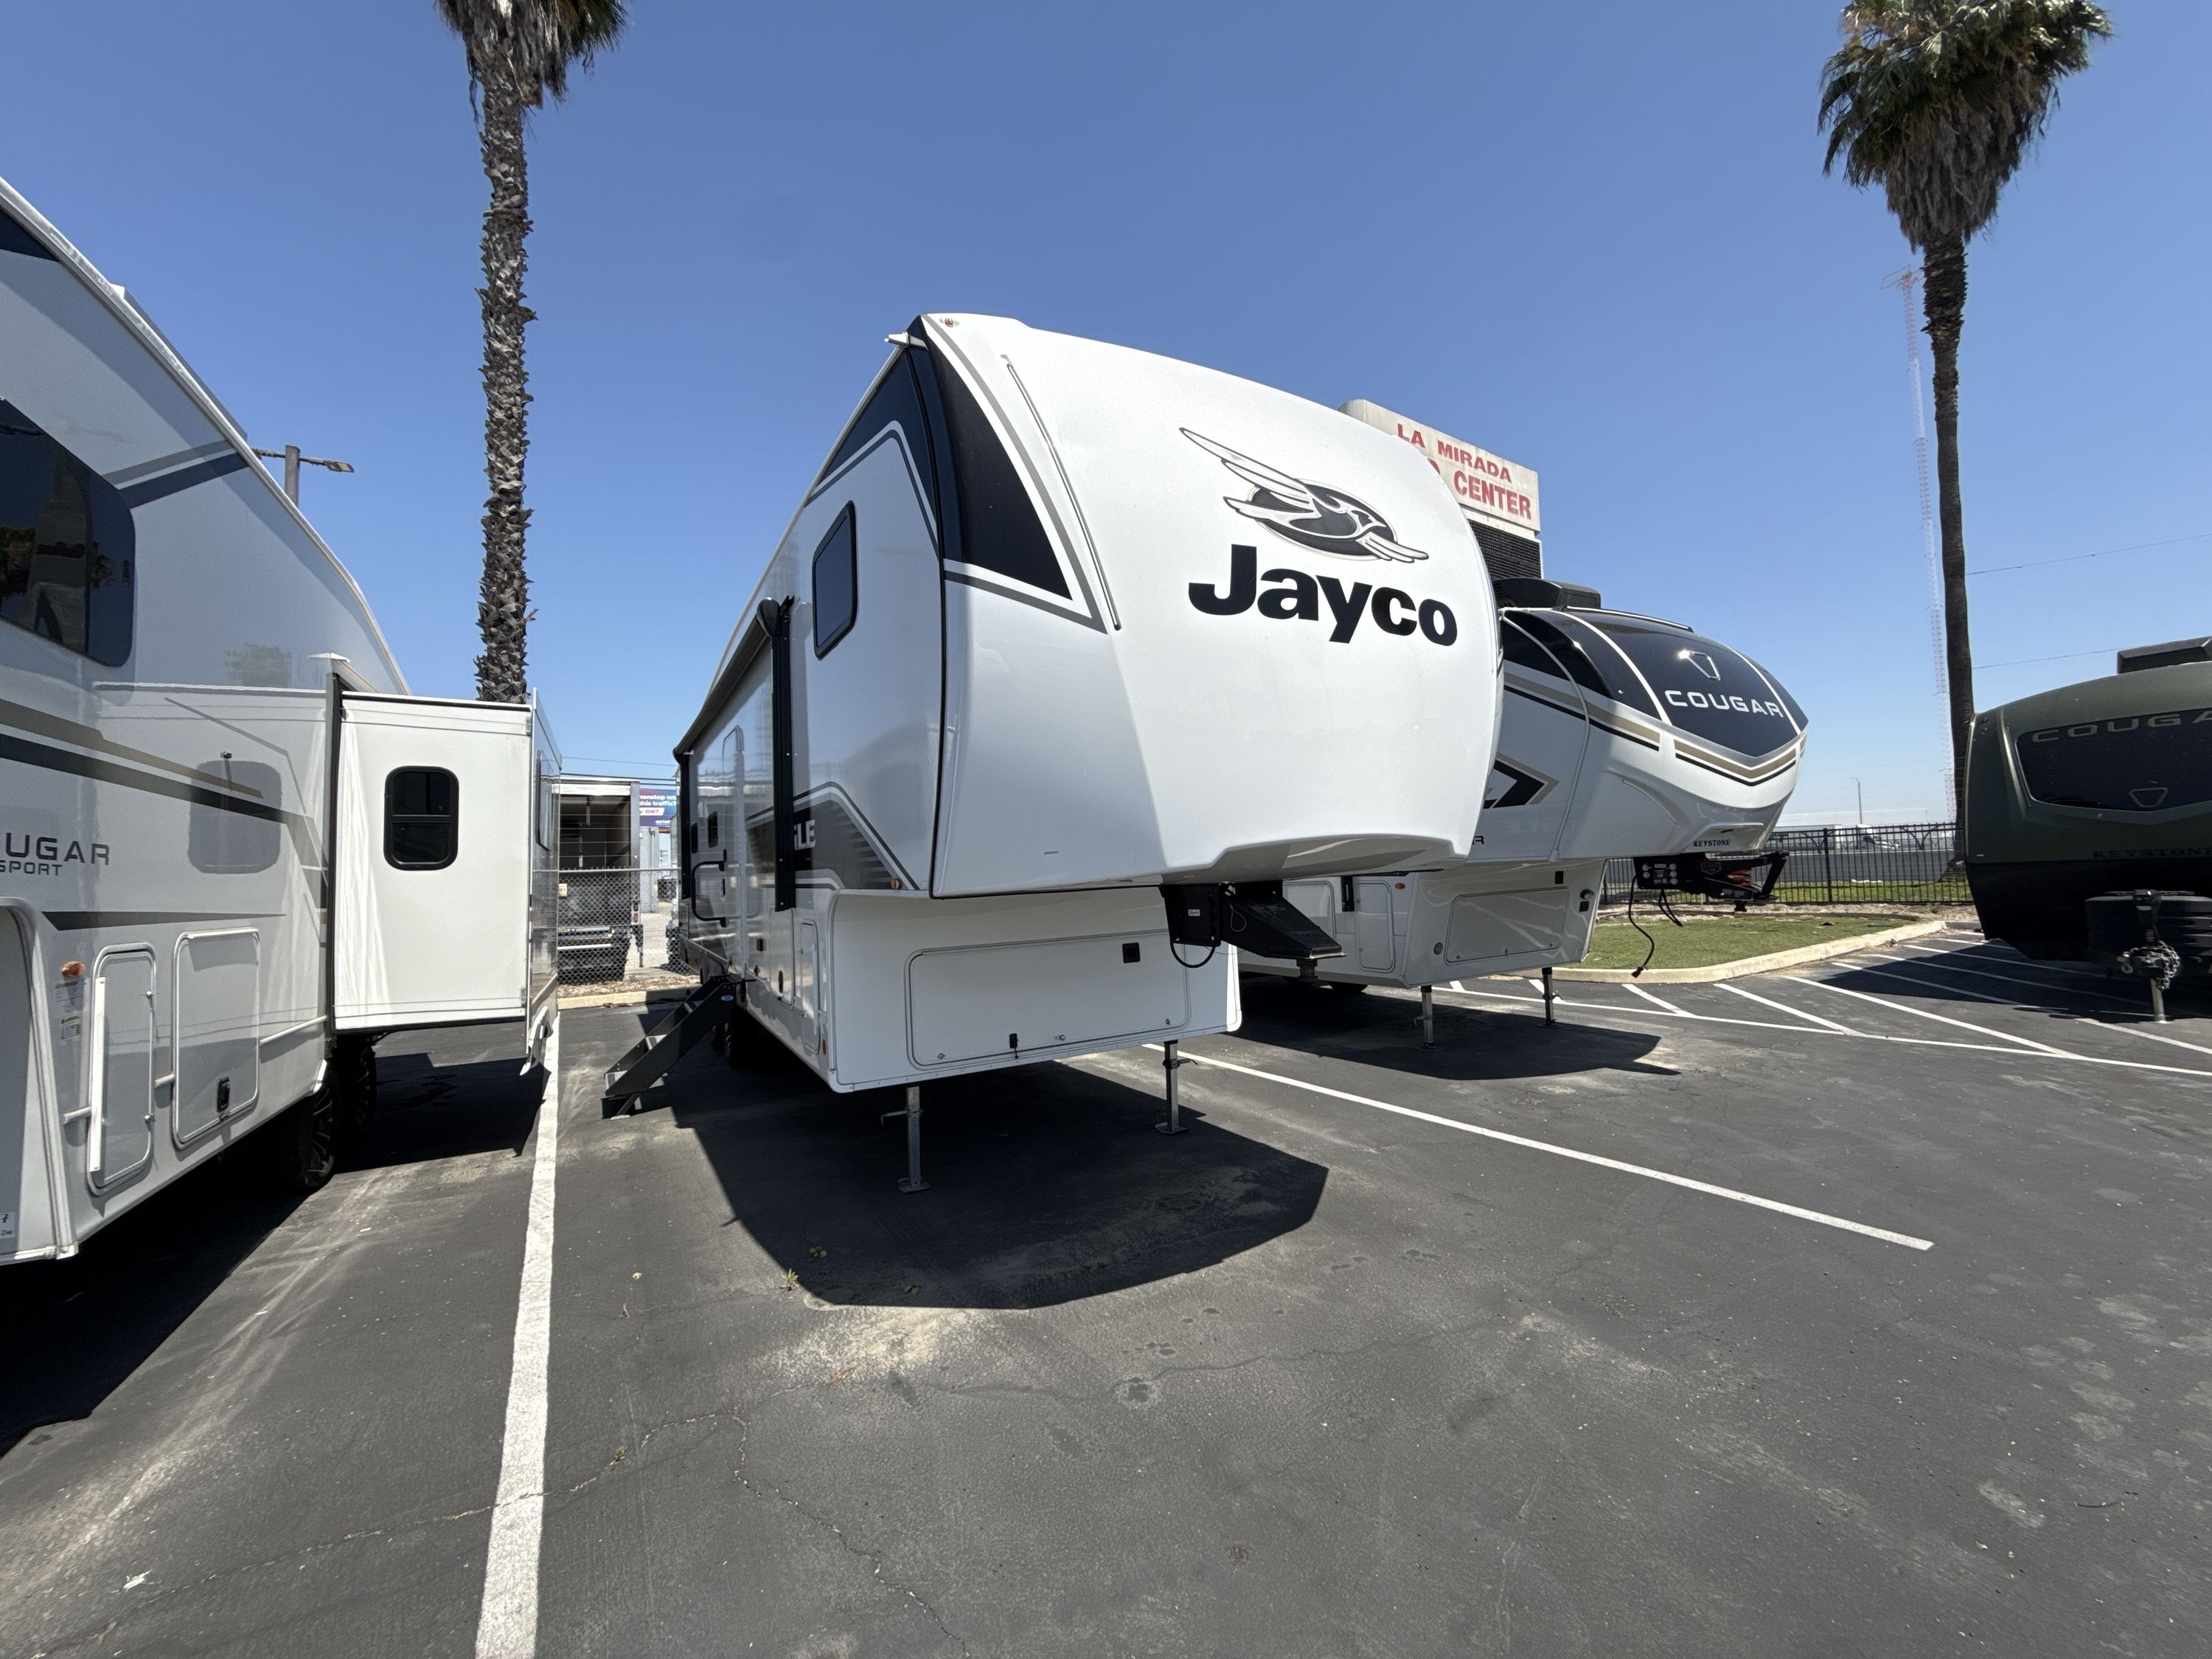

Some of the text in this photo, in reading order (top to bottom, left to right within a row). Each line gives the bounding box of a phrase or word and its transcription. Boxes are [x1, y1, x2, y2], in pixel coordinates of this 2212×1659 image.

[1397, 423, 1425, 448] LA
[1438, 440, 1512, 483] MIRADA
[1454, 470, 1531, 520] CENTER
[1188, 543, 1458, 646] Jayco
[1664, 690, 1784, 717] COUGAR
[2032, 711, 2212, 742] COUGA
[6, 832, 109, 866] UGAR
[1693, 839, 1731, 847] KEYSTONE
[0, 860, 62, 876] SPORT
